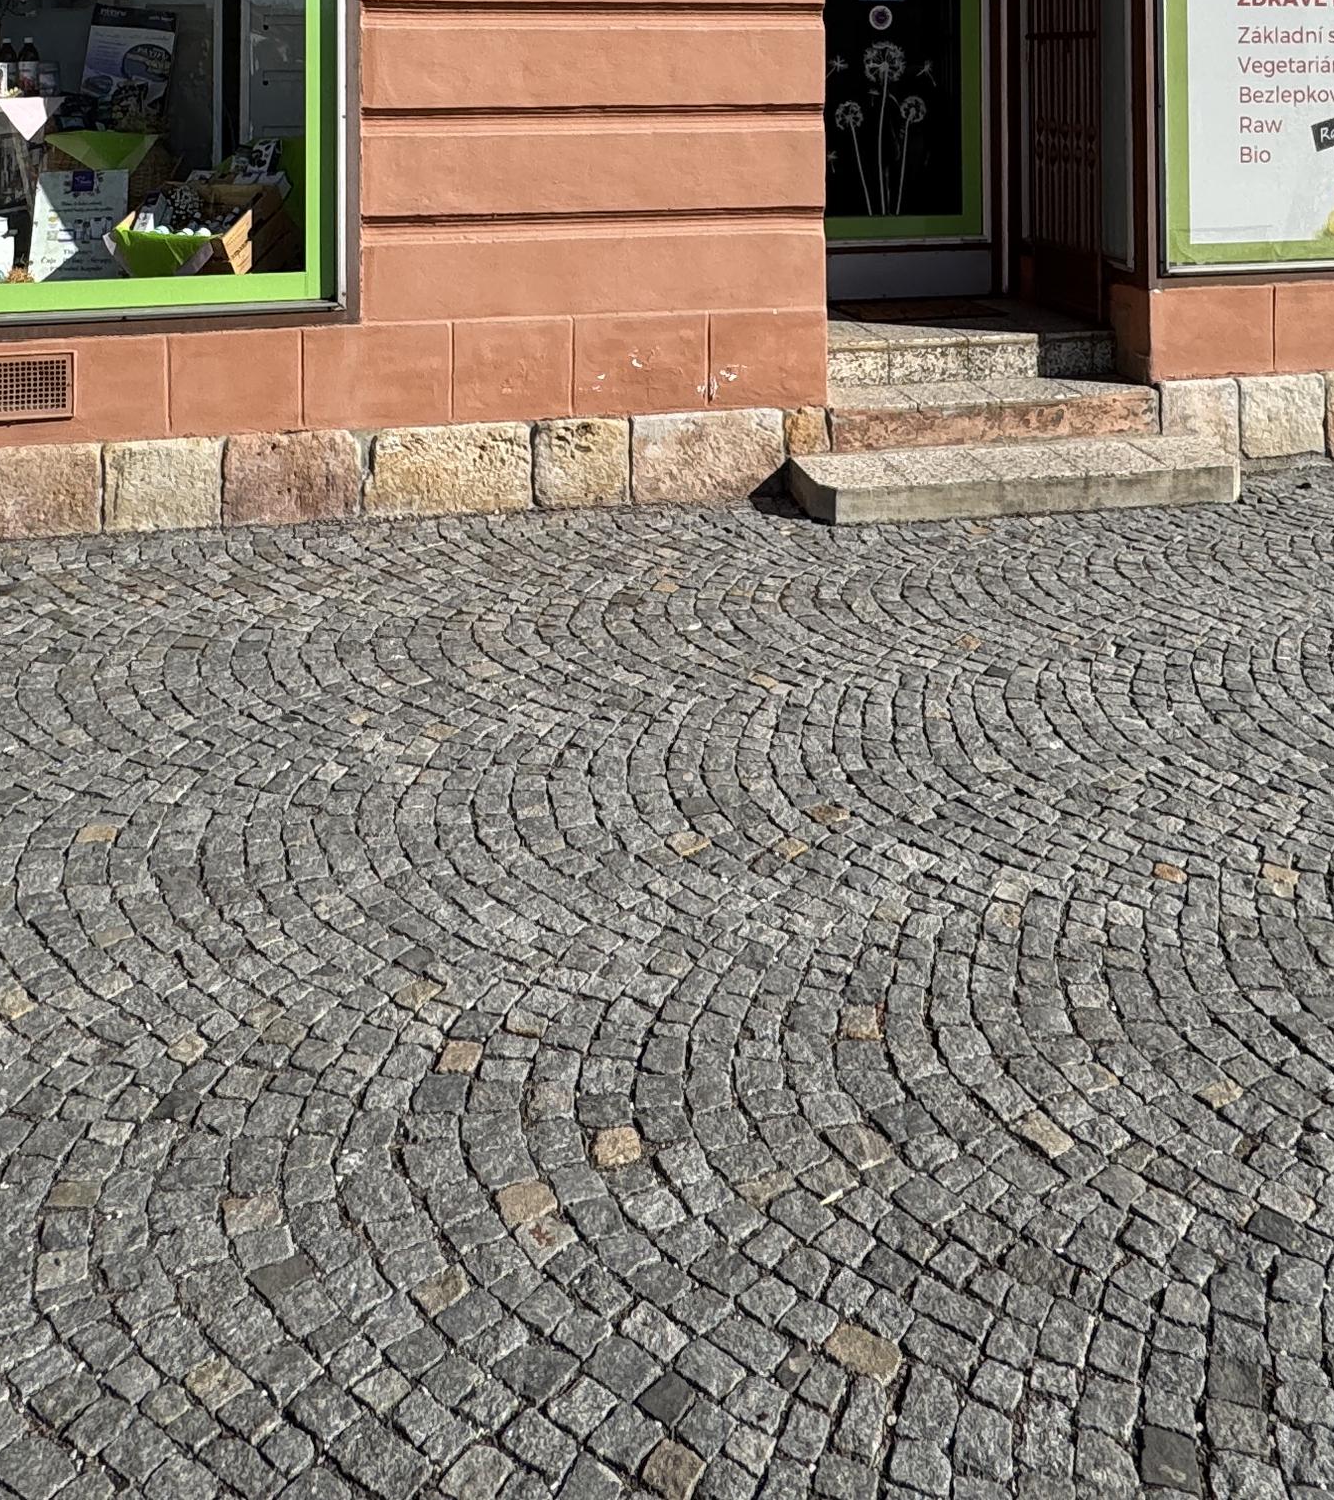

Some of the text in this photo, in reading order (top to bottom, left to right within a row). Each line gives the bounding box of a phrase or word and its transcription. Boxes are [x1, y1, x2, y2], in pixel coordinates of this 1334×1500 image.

[1237, 25, 1323, 45] Základní
[1239, 116, 1283, 134] Raw
[1239, 146, 1271, 164] Bio
